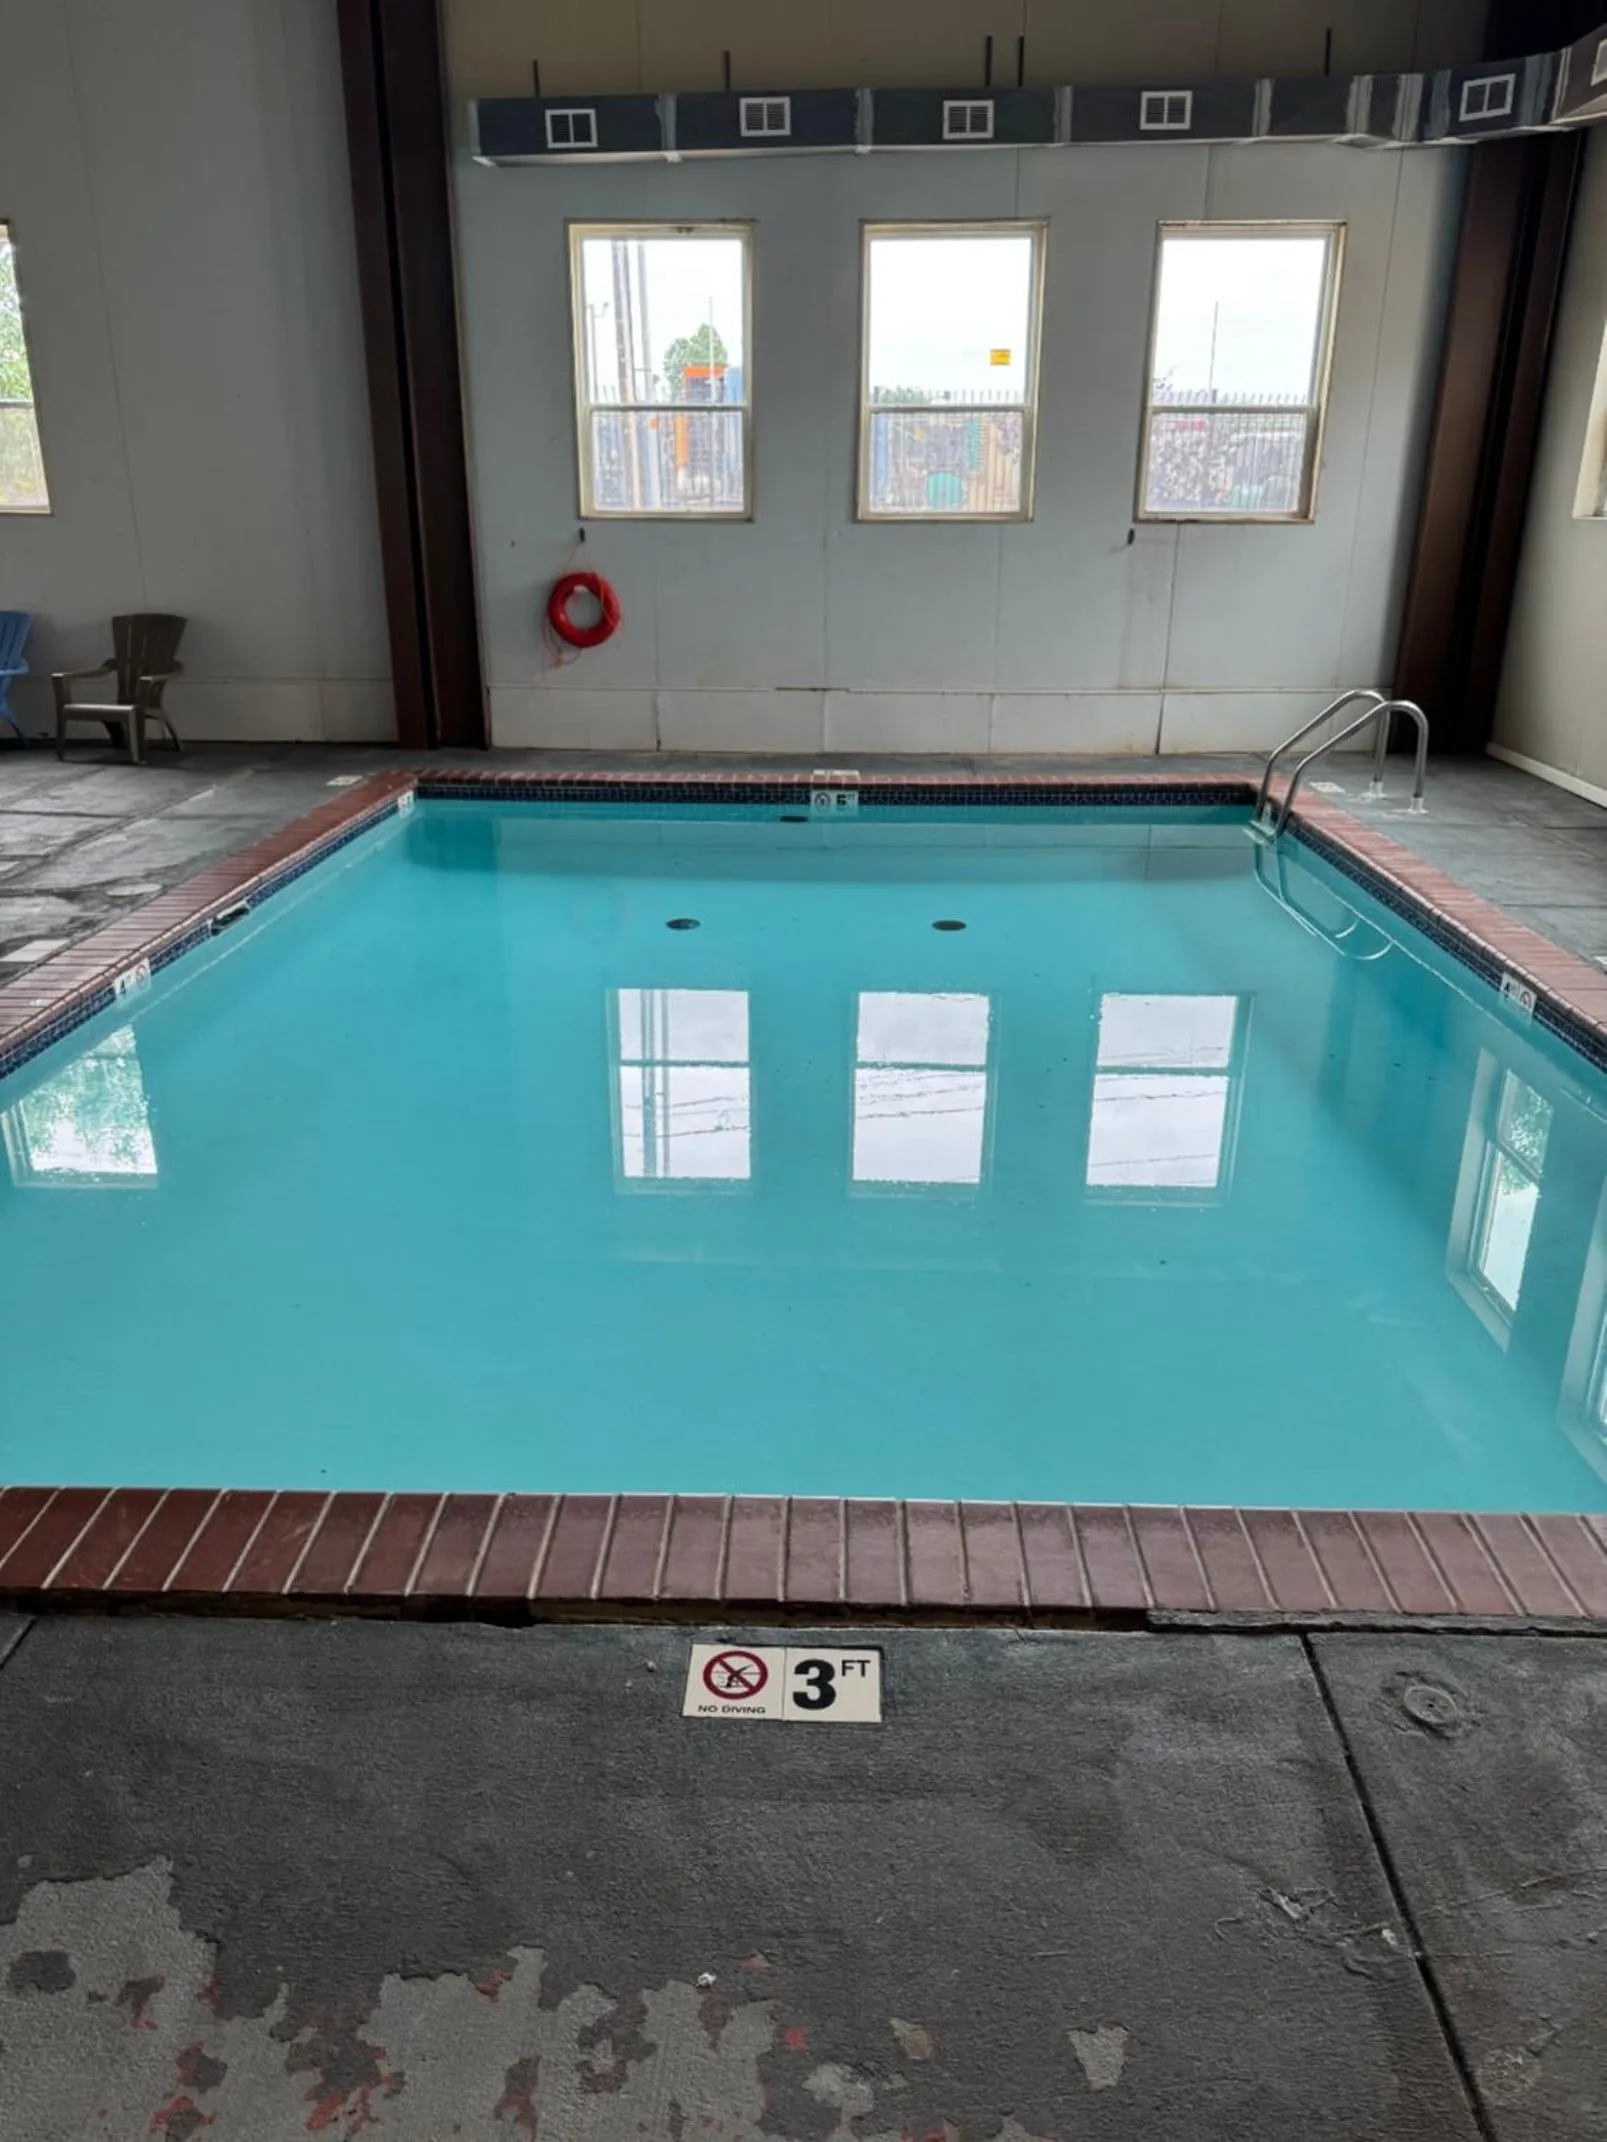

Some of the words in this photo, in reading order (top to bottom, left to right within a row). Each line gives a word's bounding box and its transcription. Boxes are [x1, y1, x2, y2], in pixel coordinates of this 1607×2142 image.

[792, 1658, 836, 1710] 3
[841, 1659, 871, 1677] FT
[698, 1704, 718, 1713] NO
[721, 1705, 766, 1714] DIVING
